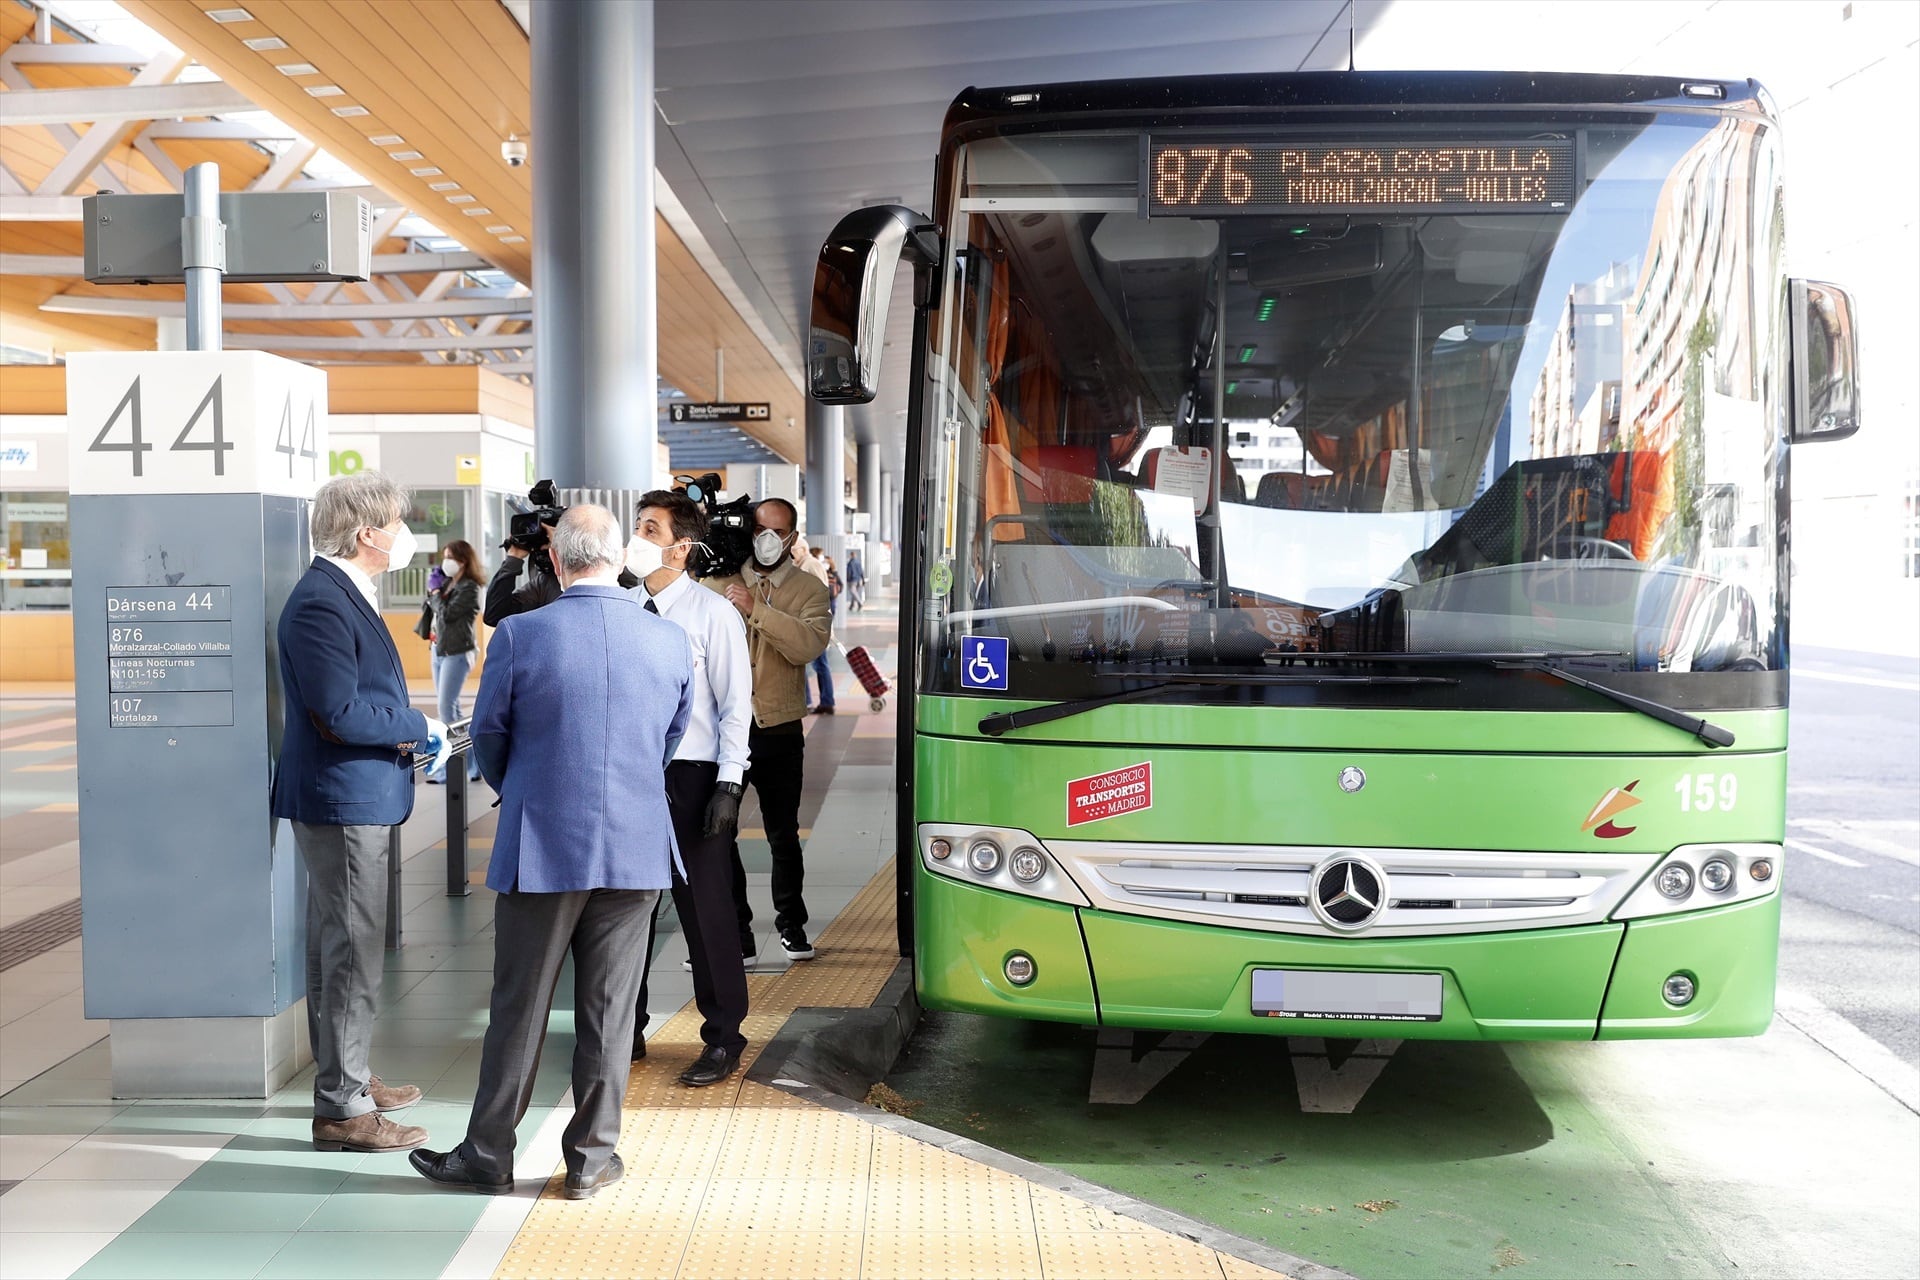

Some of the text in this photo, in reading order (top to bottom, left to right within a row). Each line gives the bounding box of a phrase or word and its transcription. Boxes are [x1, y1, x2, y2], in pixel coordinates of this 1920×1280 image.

[1282, 149, 1550, 173] PLAZA CASTILLA
[1157, 148, 1252, 205] 876
[87, 373, 234, 477] 44
[274, 386, 319, 483] 44
[108, 592, 213, 612] Dársena 44
[112, 628, 143, 642] 876
[110, 643, 230, 651] Moralzarzal-Collado Villalba
[147, 659, 195, 667] Nocturnas
[111, 669, 166, 679] N101-155
[112, 699, 142, 712] 107
[111, 713, 158, 722] Hortaleza
[1089, 767, 1145, 791] CONSORCIO
[1075, 781, 1145, 807] TRANSPORTES
[1674, 772, 1738, 812] 159
[1107, 794, 1145, 813] MADRID
